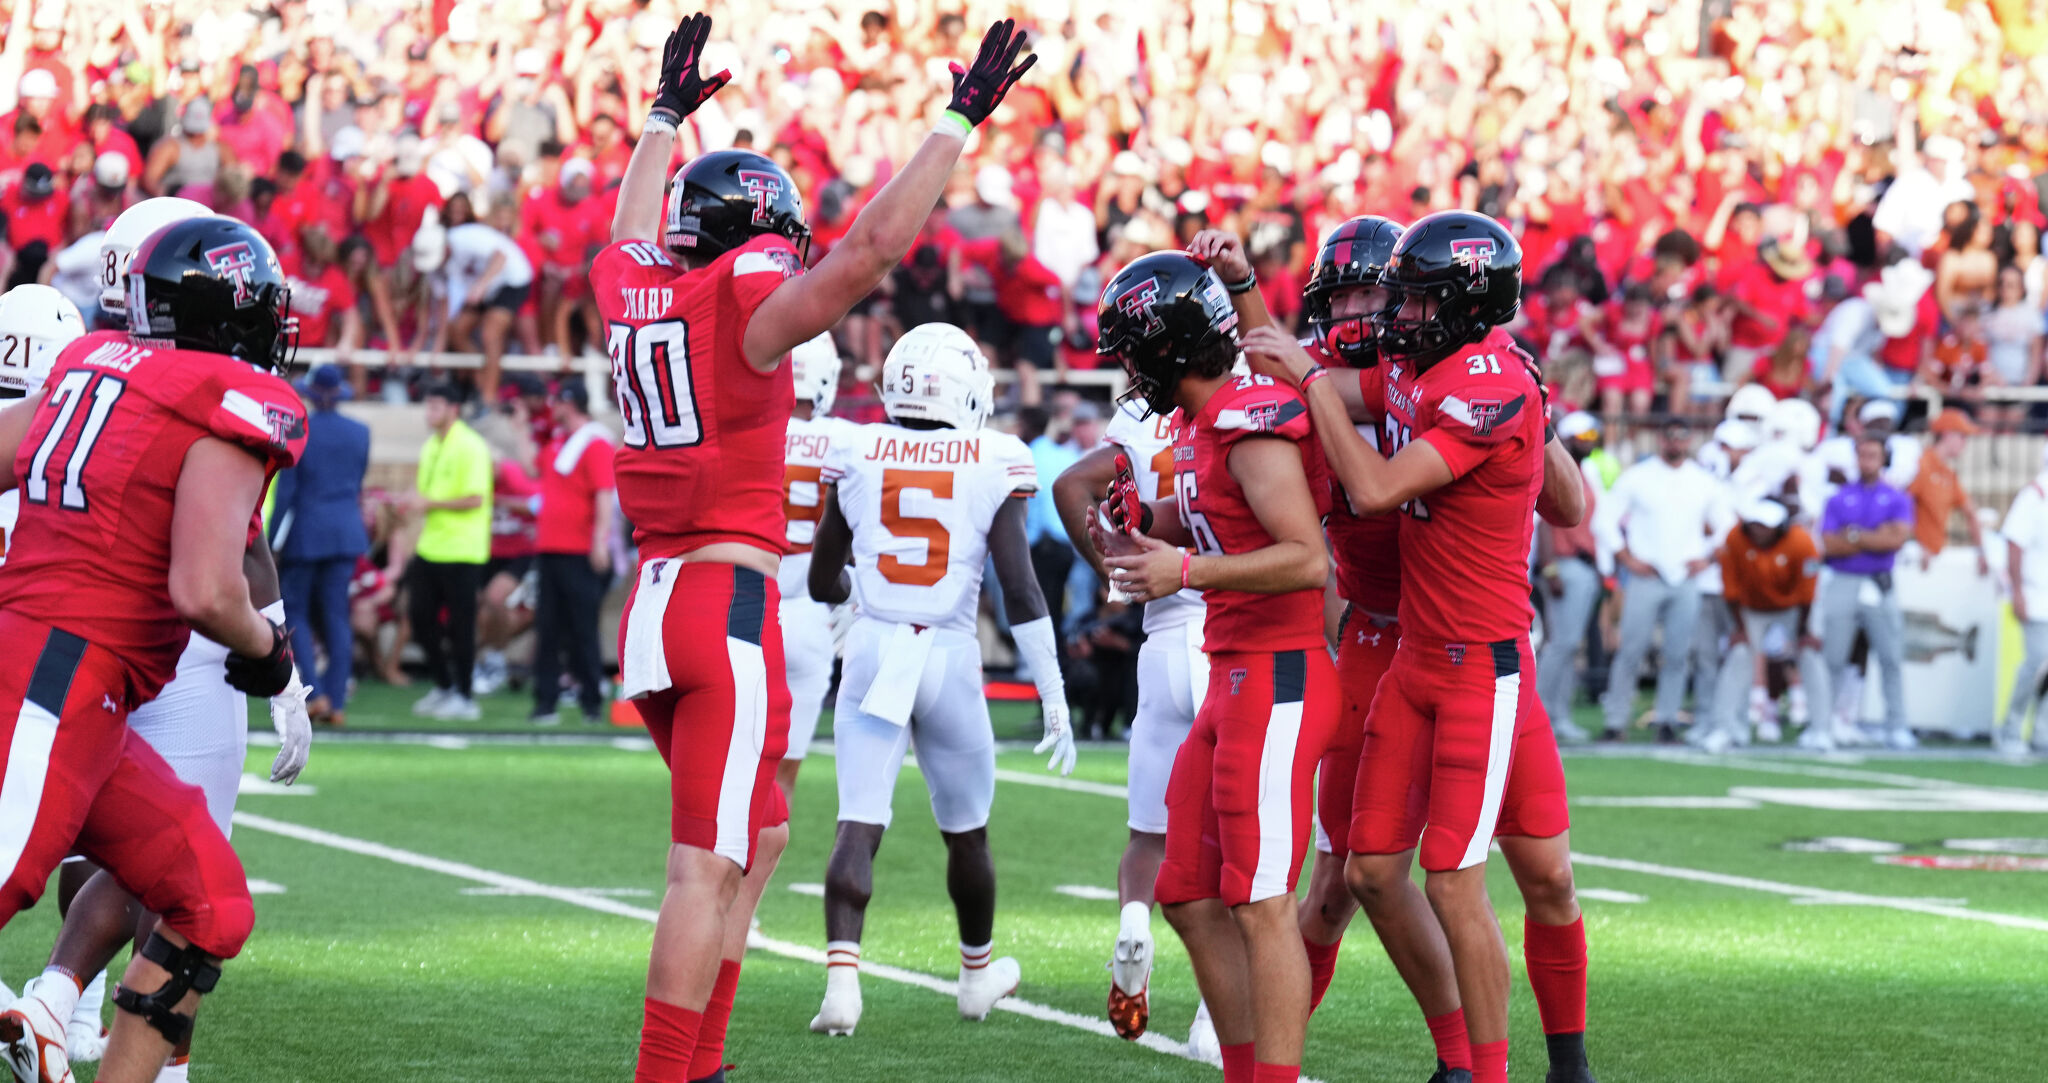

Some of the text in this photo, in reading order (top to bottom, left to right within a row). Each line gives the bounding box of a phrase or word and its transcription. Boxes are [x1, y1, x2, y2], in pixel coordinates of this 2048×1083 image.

[3, 334, 31, 368] 21
[1466, 354, 1502, 375] 31
[607, 318, 703, 449] 80
[902, 364, 914, 394] 5
[28, 369, 127, 512] 71
[865, 437, 980, 464] JAMISON
[876, 468, 954, 587] 5
